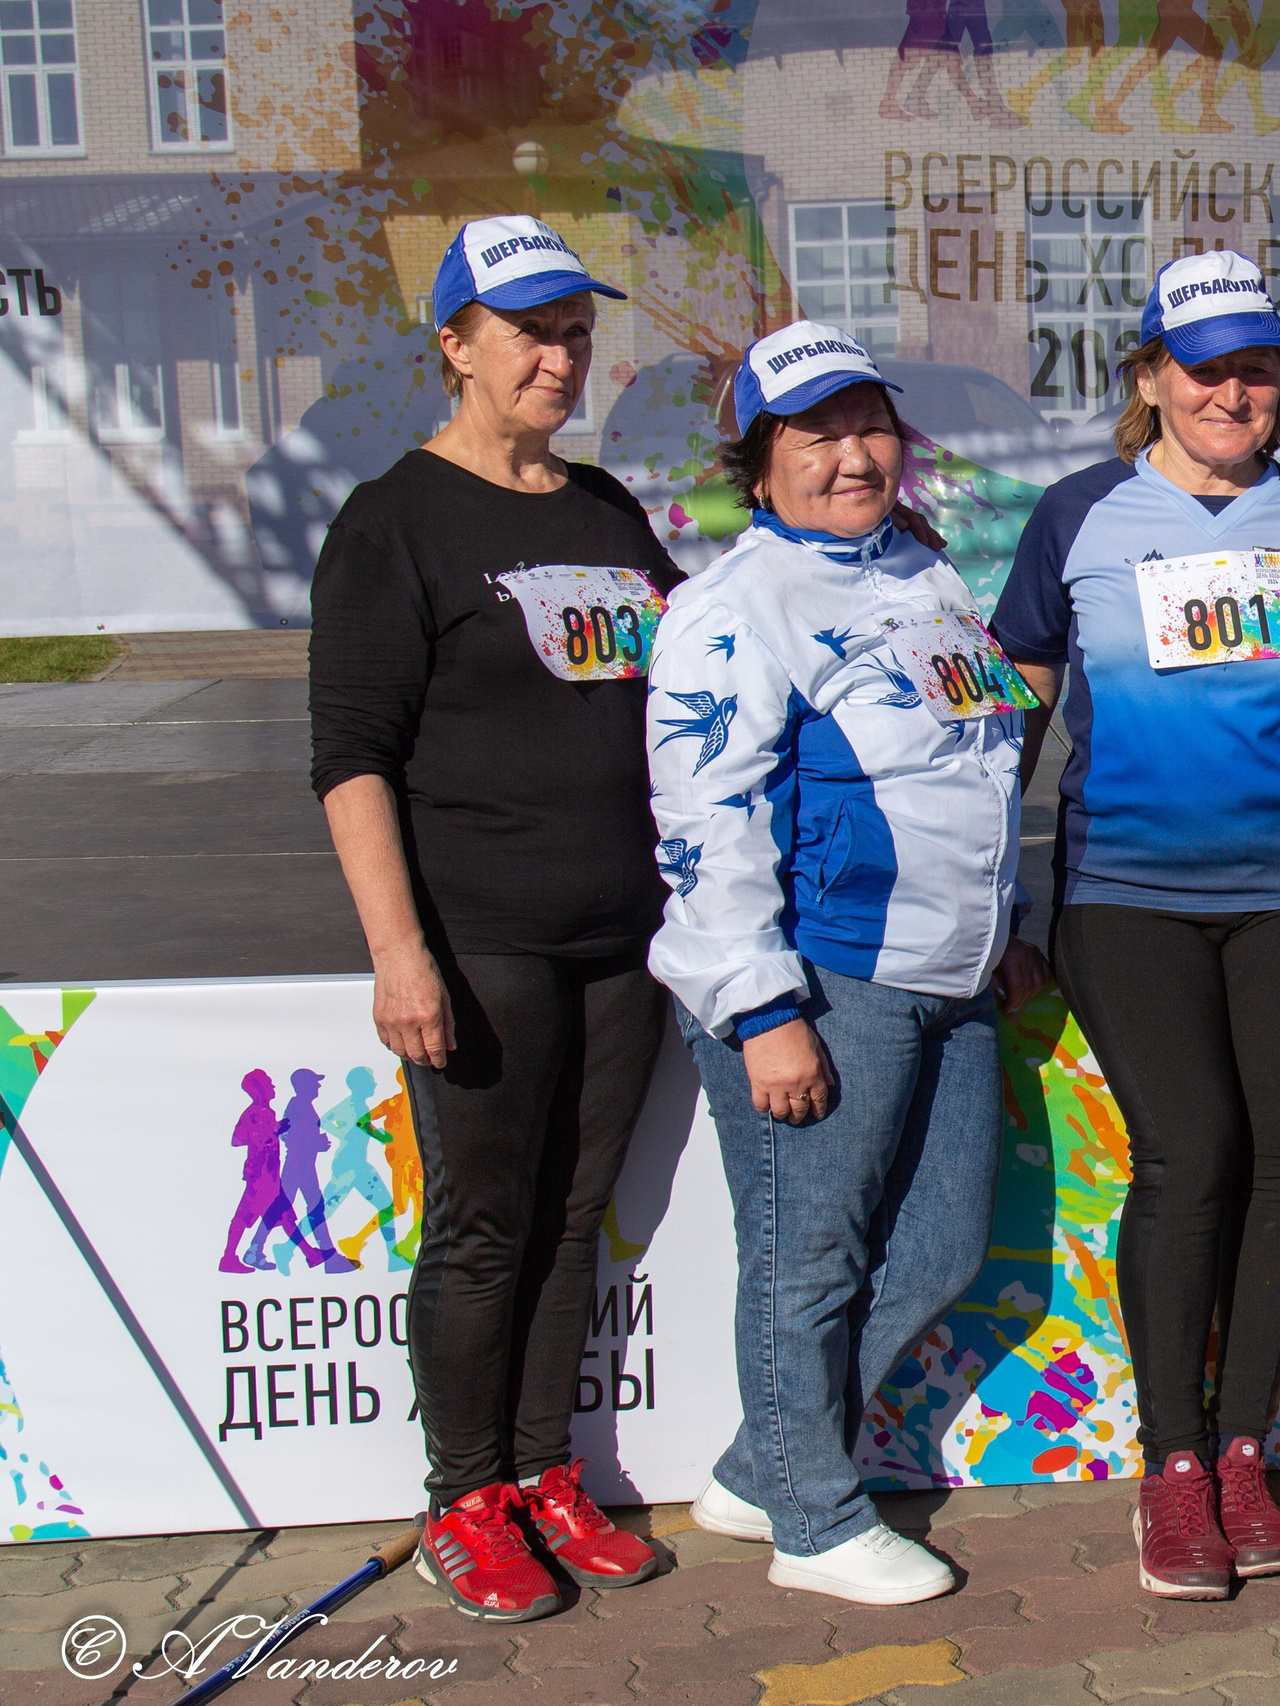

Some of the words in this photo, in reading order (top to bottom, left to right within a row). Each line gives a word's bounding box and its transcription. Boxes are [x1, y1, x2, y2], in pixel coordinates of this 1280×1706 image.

[883, 227, 1050, 305] ДЕНЬ
[1167, 278, 1259, 309] ШЕРБАКУЛЬ
[766, 338, 866, 376] ШЕРБАКУЛЬ
[562, 605, 643, 665] 803
[1183, 594, 1272, 651] 801
[931, 651, 1006, 706] 804
[220, 1273, 654, 1353] ВСЕРОСИЙ
[218, 1360, 381, 1442] ДЕНЬ
